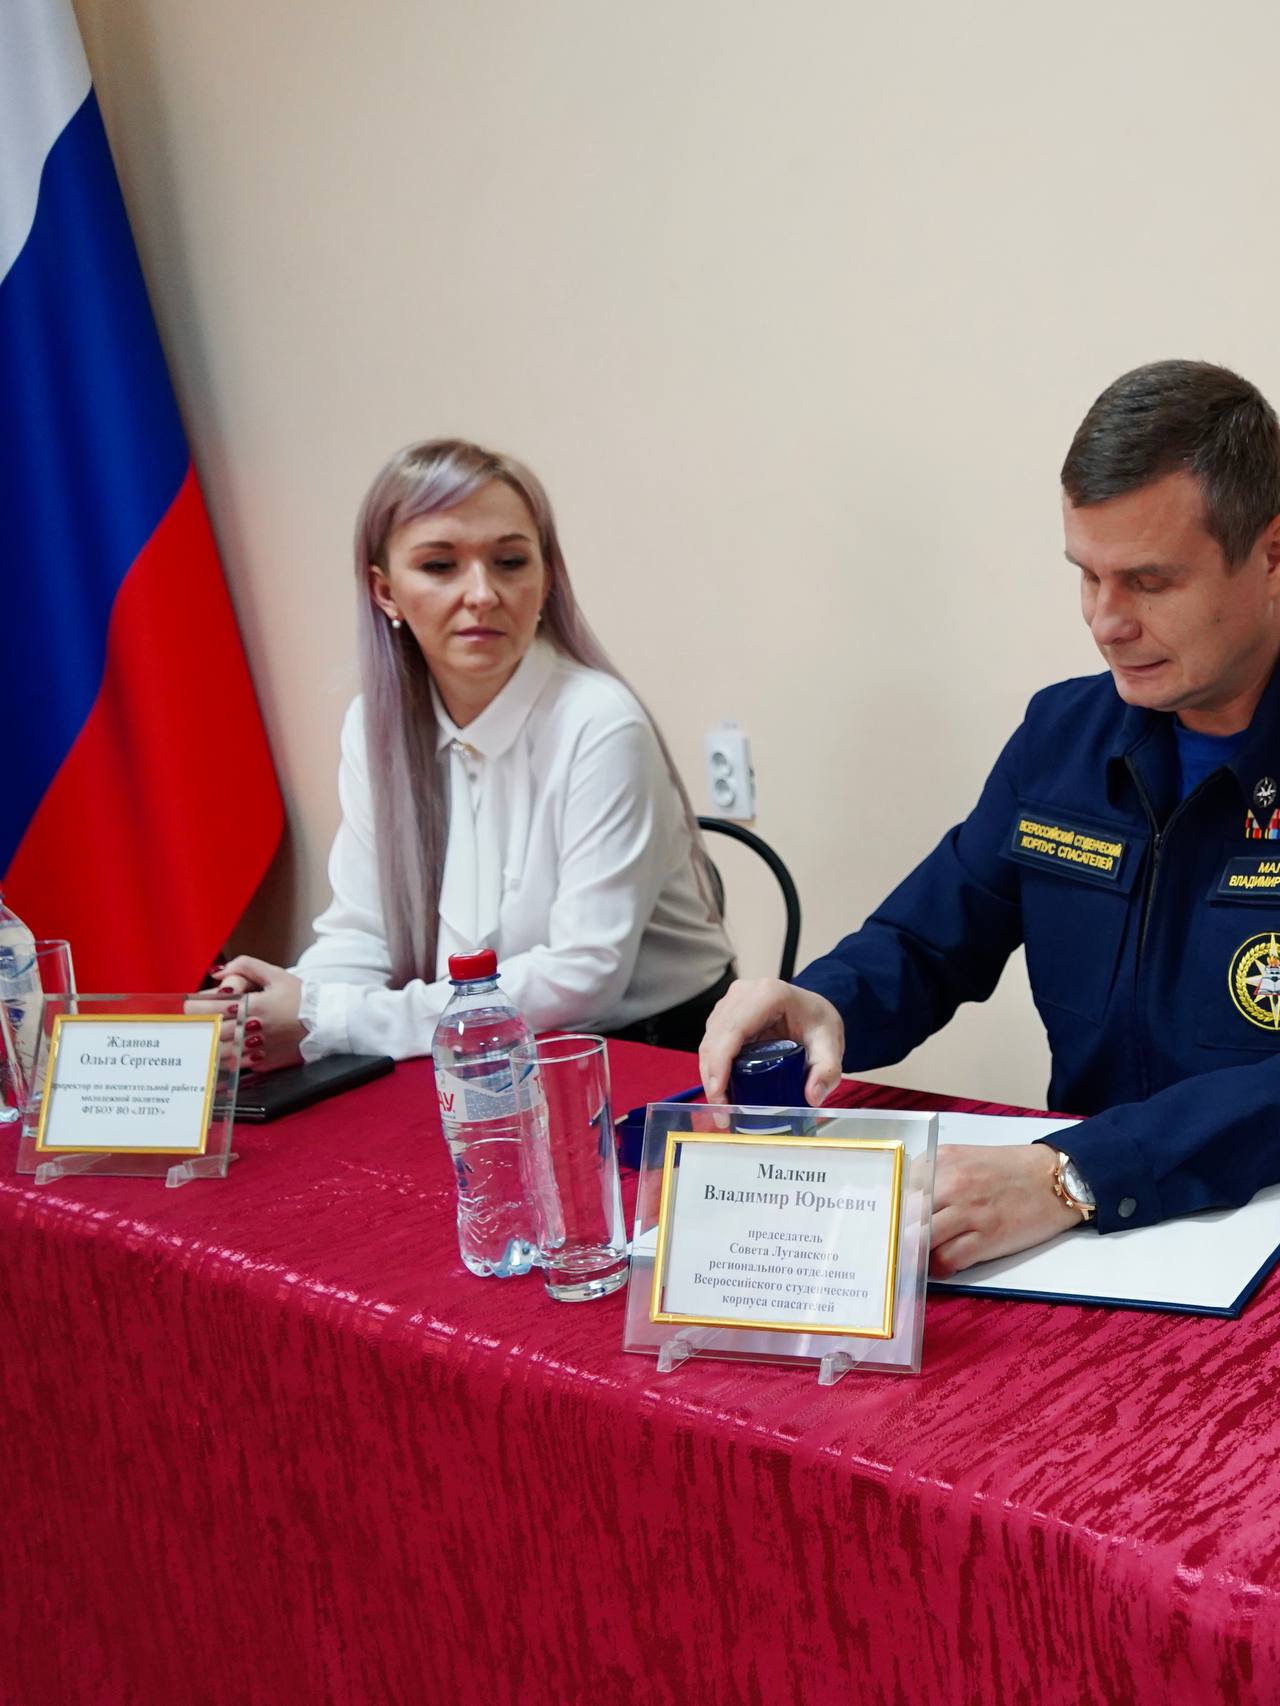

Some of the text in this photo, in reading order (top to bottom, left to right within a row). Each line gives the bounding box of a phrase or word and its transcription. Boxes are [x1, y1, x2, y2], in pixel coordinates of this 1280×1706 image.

[1021, 835, 1114, 871] КОРПУС СПАСАТЕЛЕЙ
[1229, 875, 1280, 889] ВЛАДИМИР
[106, 1035, 160, 1049] Жданова
[80, 1053, 182, 1069] Ольга Сергеевна
[116, 1105, 129, 1115] ВО
[756, 1163, 827, 1183] Малкин
[704, 1184, 877, 1212] Владимир Юрьевич
[748, 1229, 823, 1244] председатель
[729, 1242, 839, 1262] Совета Луганского
[709, 1260, 856, 1280] регионального отделения
[694, 1273, 868, 1299] Всероссийского студенческого
[722, 1295, 835, 1313] корпуса спасателей
